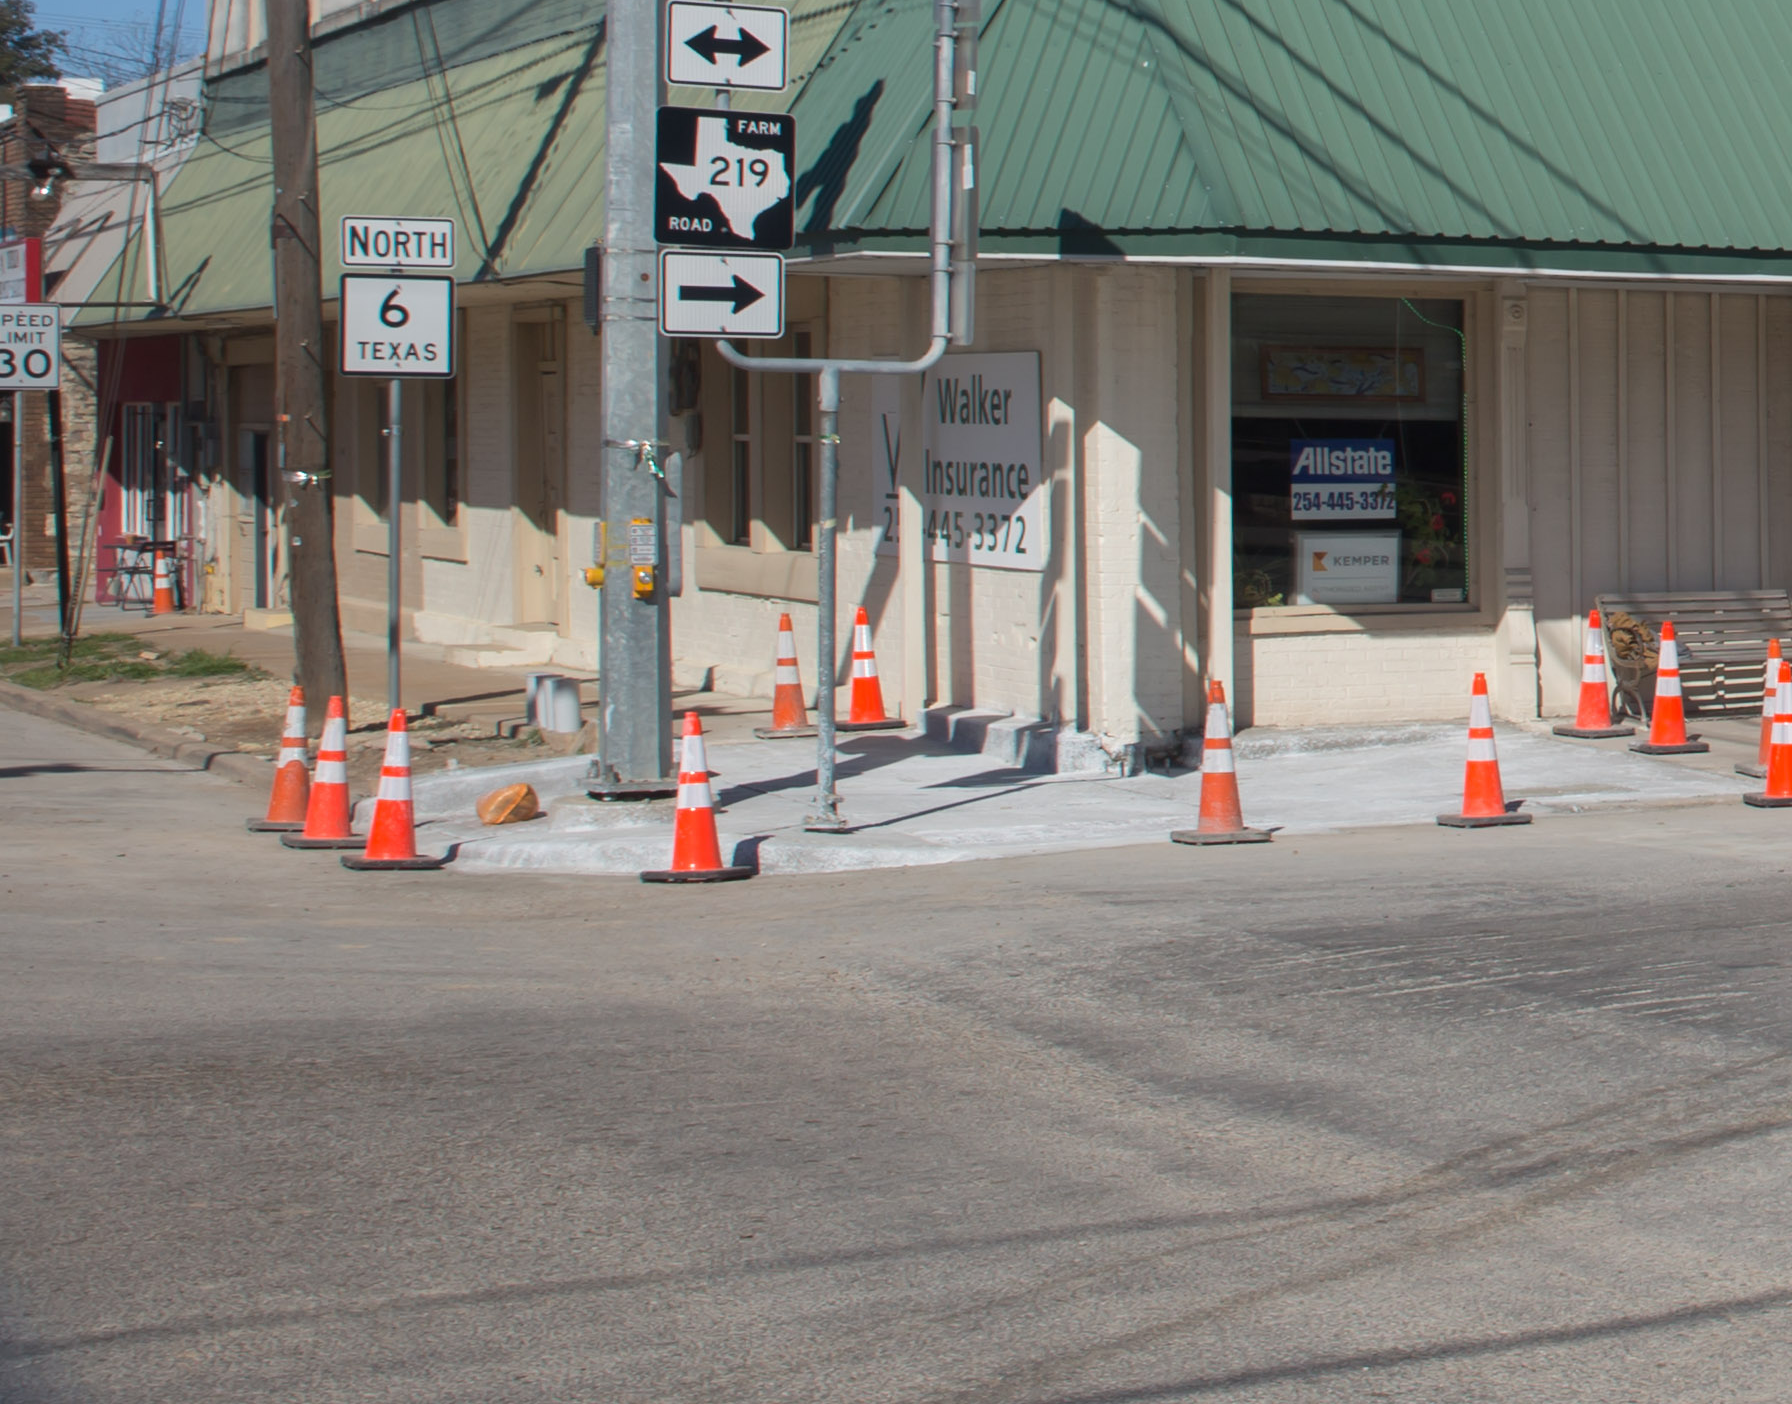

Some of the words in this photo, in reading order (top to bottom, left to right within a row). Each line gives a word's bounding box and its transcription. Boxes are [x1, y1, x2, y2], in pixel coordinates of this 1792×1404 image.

[737, 119, 781, 136] FARM
[709, 156, 769, 188] 219
[668, 216, 712, 232] ROAD
[350, 225, 447, 258] NORTH
[0, 314, 54, 327] PEED
[379, 288, 410, 328] 6
[0, 331, 46, 344] IMIT
[357, 340, 438, 361] TEXAS
[0, 348, 52, 379] 30
[937, 374, 1013, 425] Walker
[925, 449, 1030, 499] Insurance
[1292, 447, 1392, 475] Allstate
[1292, 490, 1395, 512] 254-445-3372
[882, 505, 1028, 555] 2-445-3372
[1332, 555, 1390, 567] KEMPER
